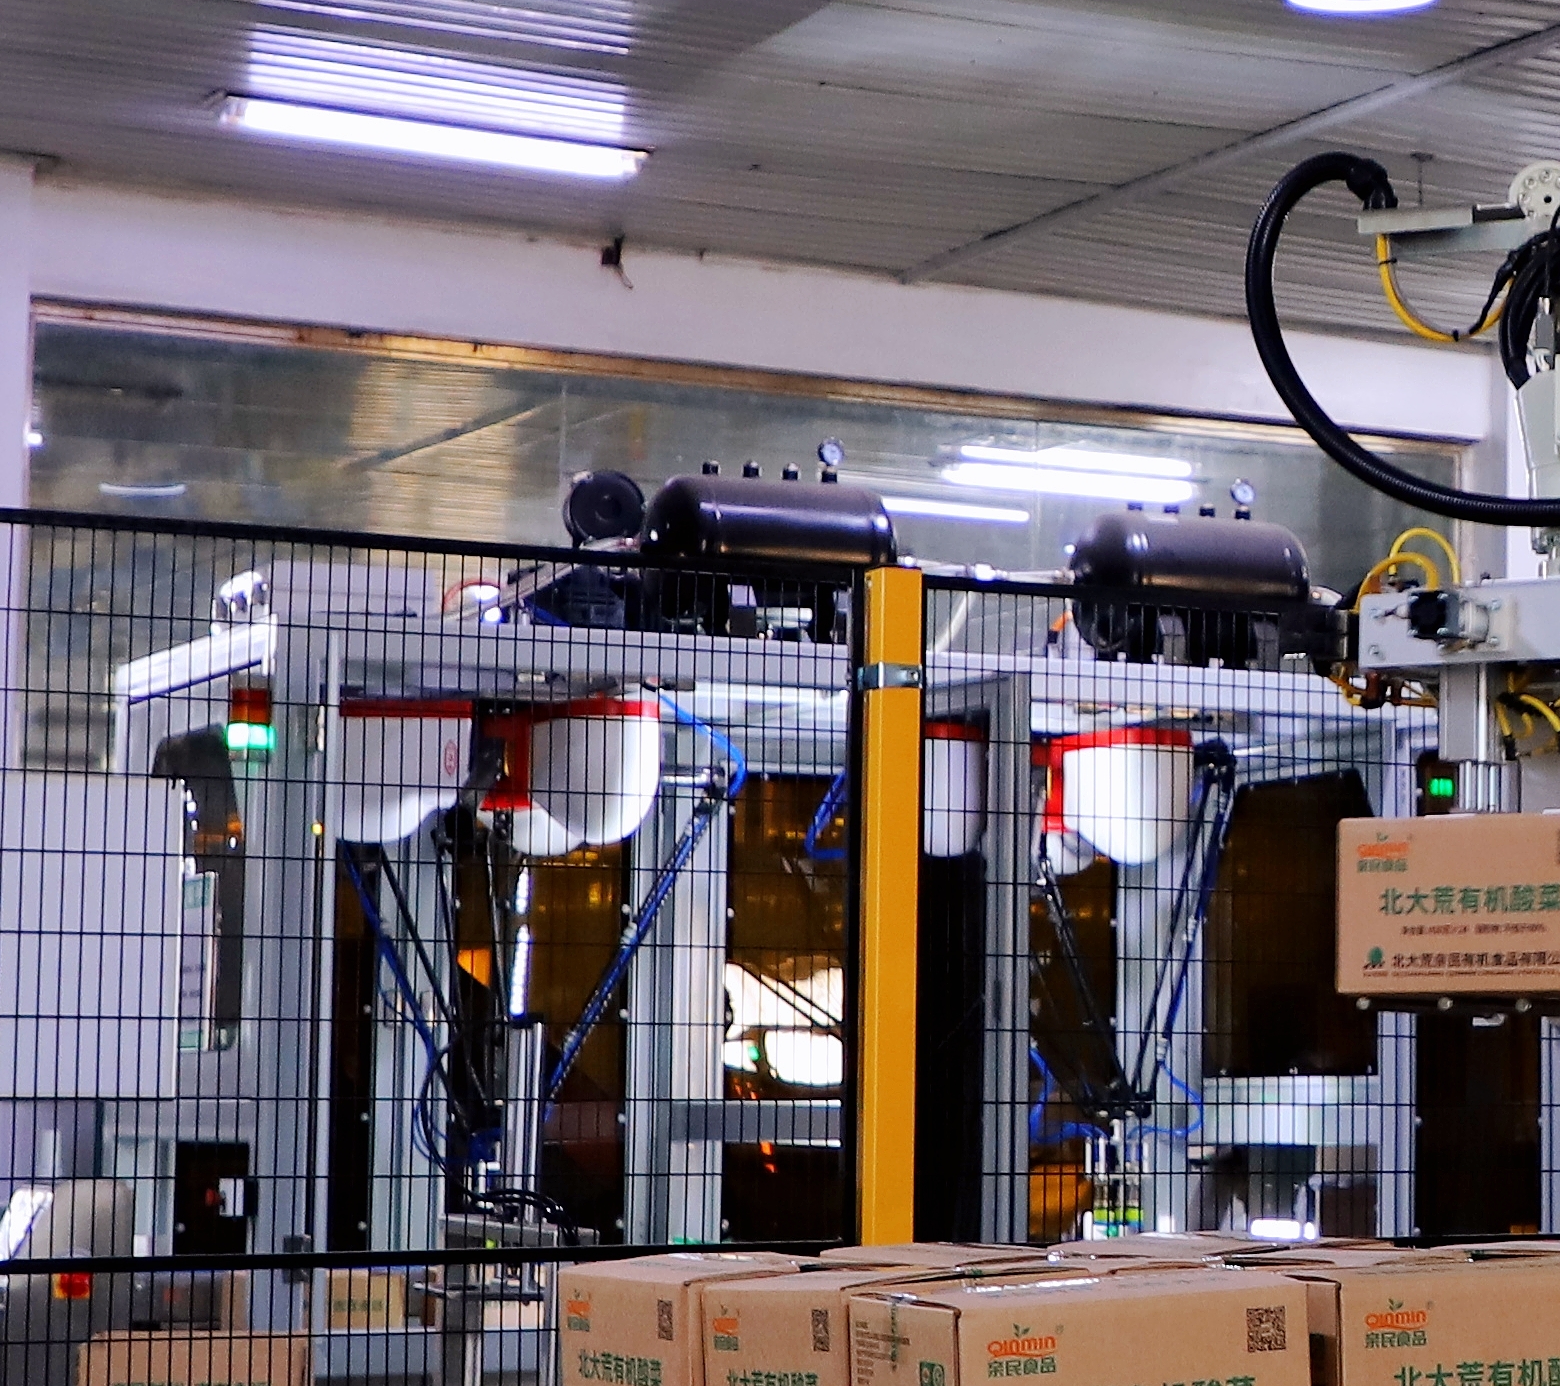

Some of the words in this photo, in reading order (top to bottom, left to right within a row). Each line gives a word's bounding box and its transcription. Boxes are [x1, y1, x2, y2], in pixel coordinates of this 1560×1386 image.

[1365, 1329, 1426, 1348] 亲民食品
[988, 1356, 1055, 1378] 亲民食品
